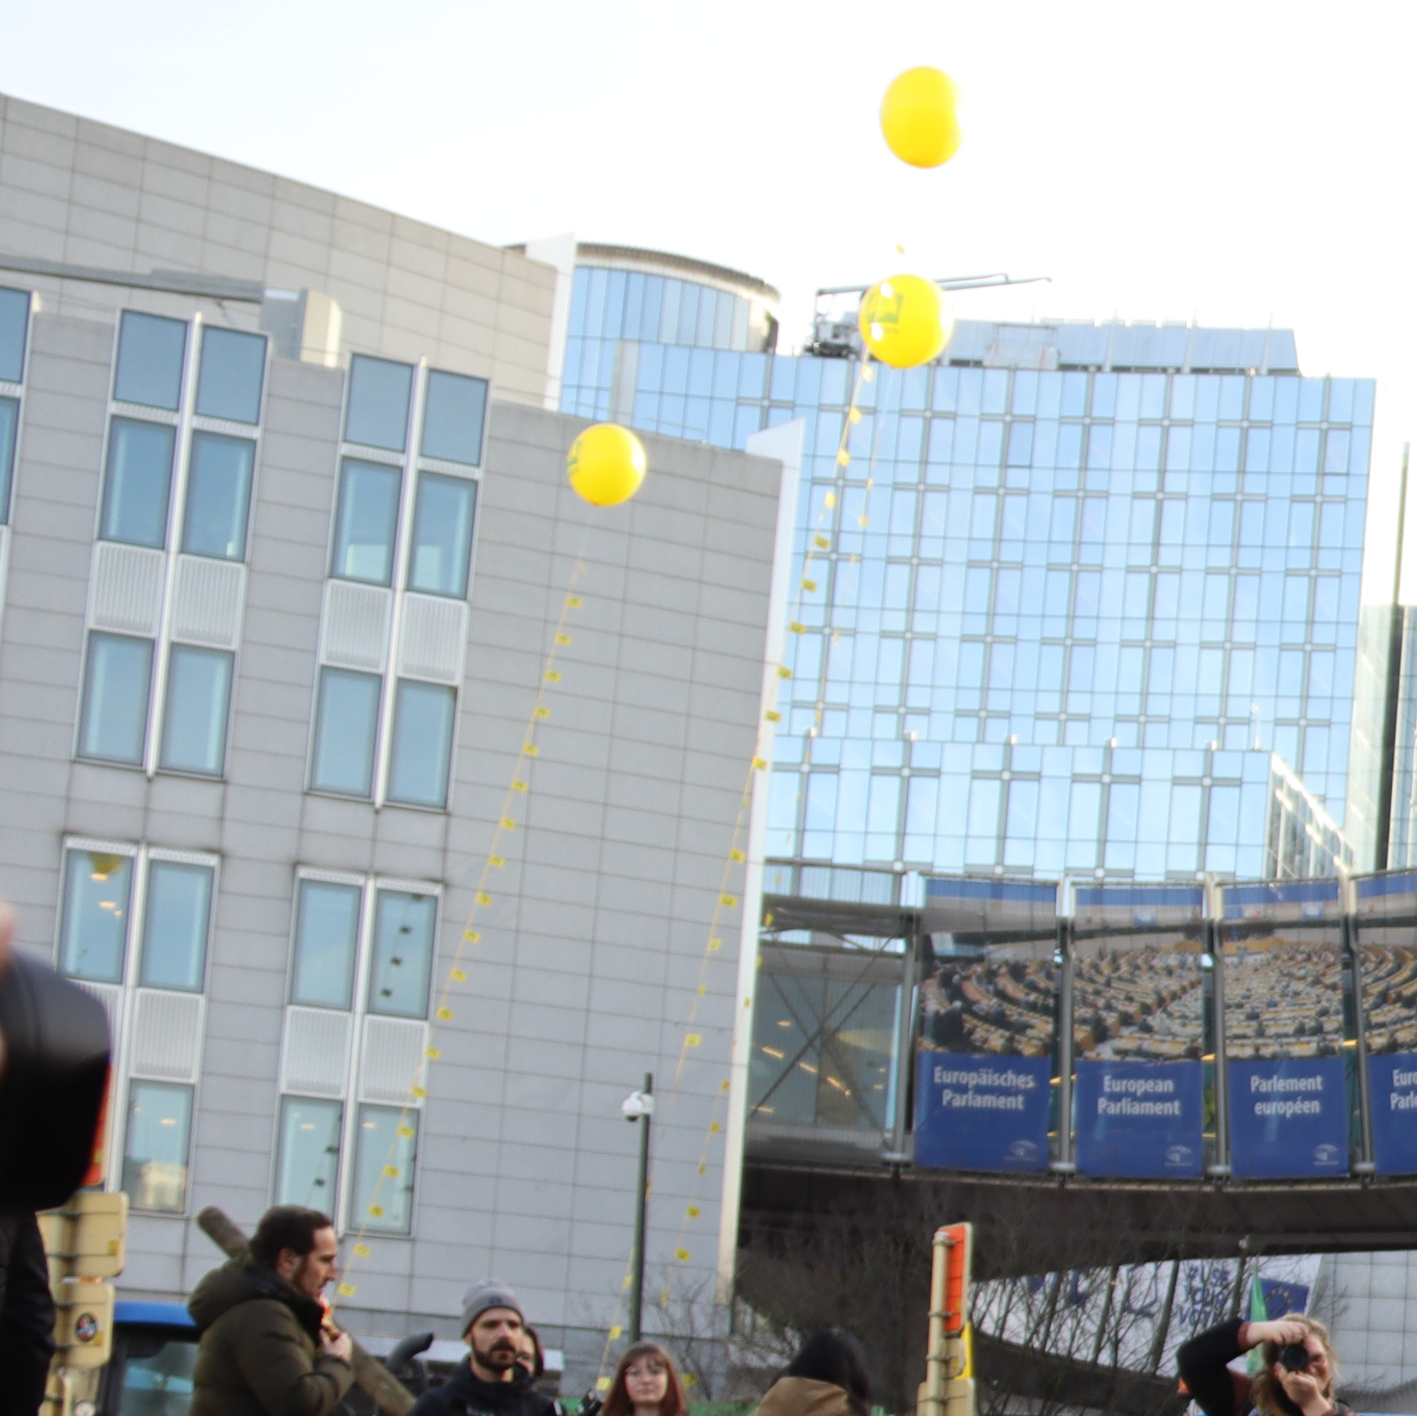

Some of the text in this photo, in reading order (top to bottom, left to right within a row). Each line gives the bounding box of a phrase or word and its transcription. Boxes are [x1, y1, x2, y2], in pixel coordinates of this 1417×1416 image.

[933, 1066, 1035, 1088] Europäisches
[1103, 1075, 1174, 1096] European
[1250, 1074, 1323, 1093] Parlement
[942, 1089, 1025, 1111] Parlament
[1097, 1097, 1181, 1115] Parliament
[1254, 1096, 1321, 1119] européen
